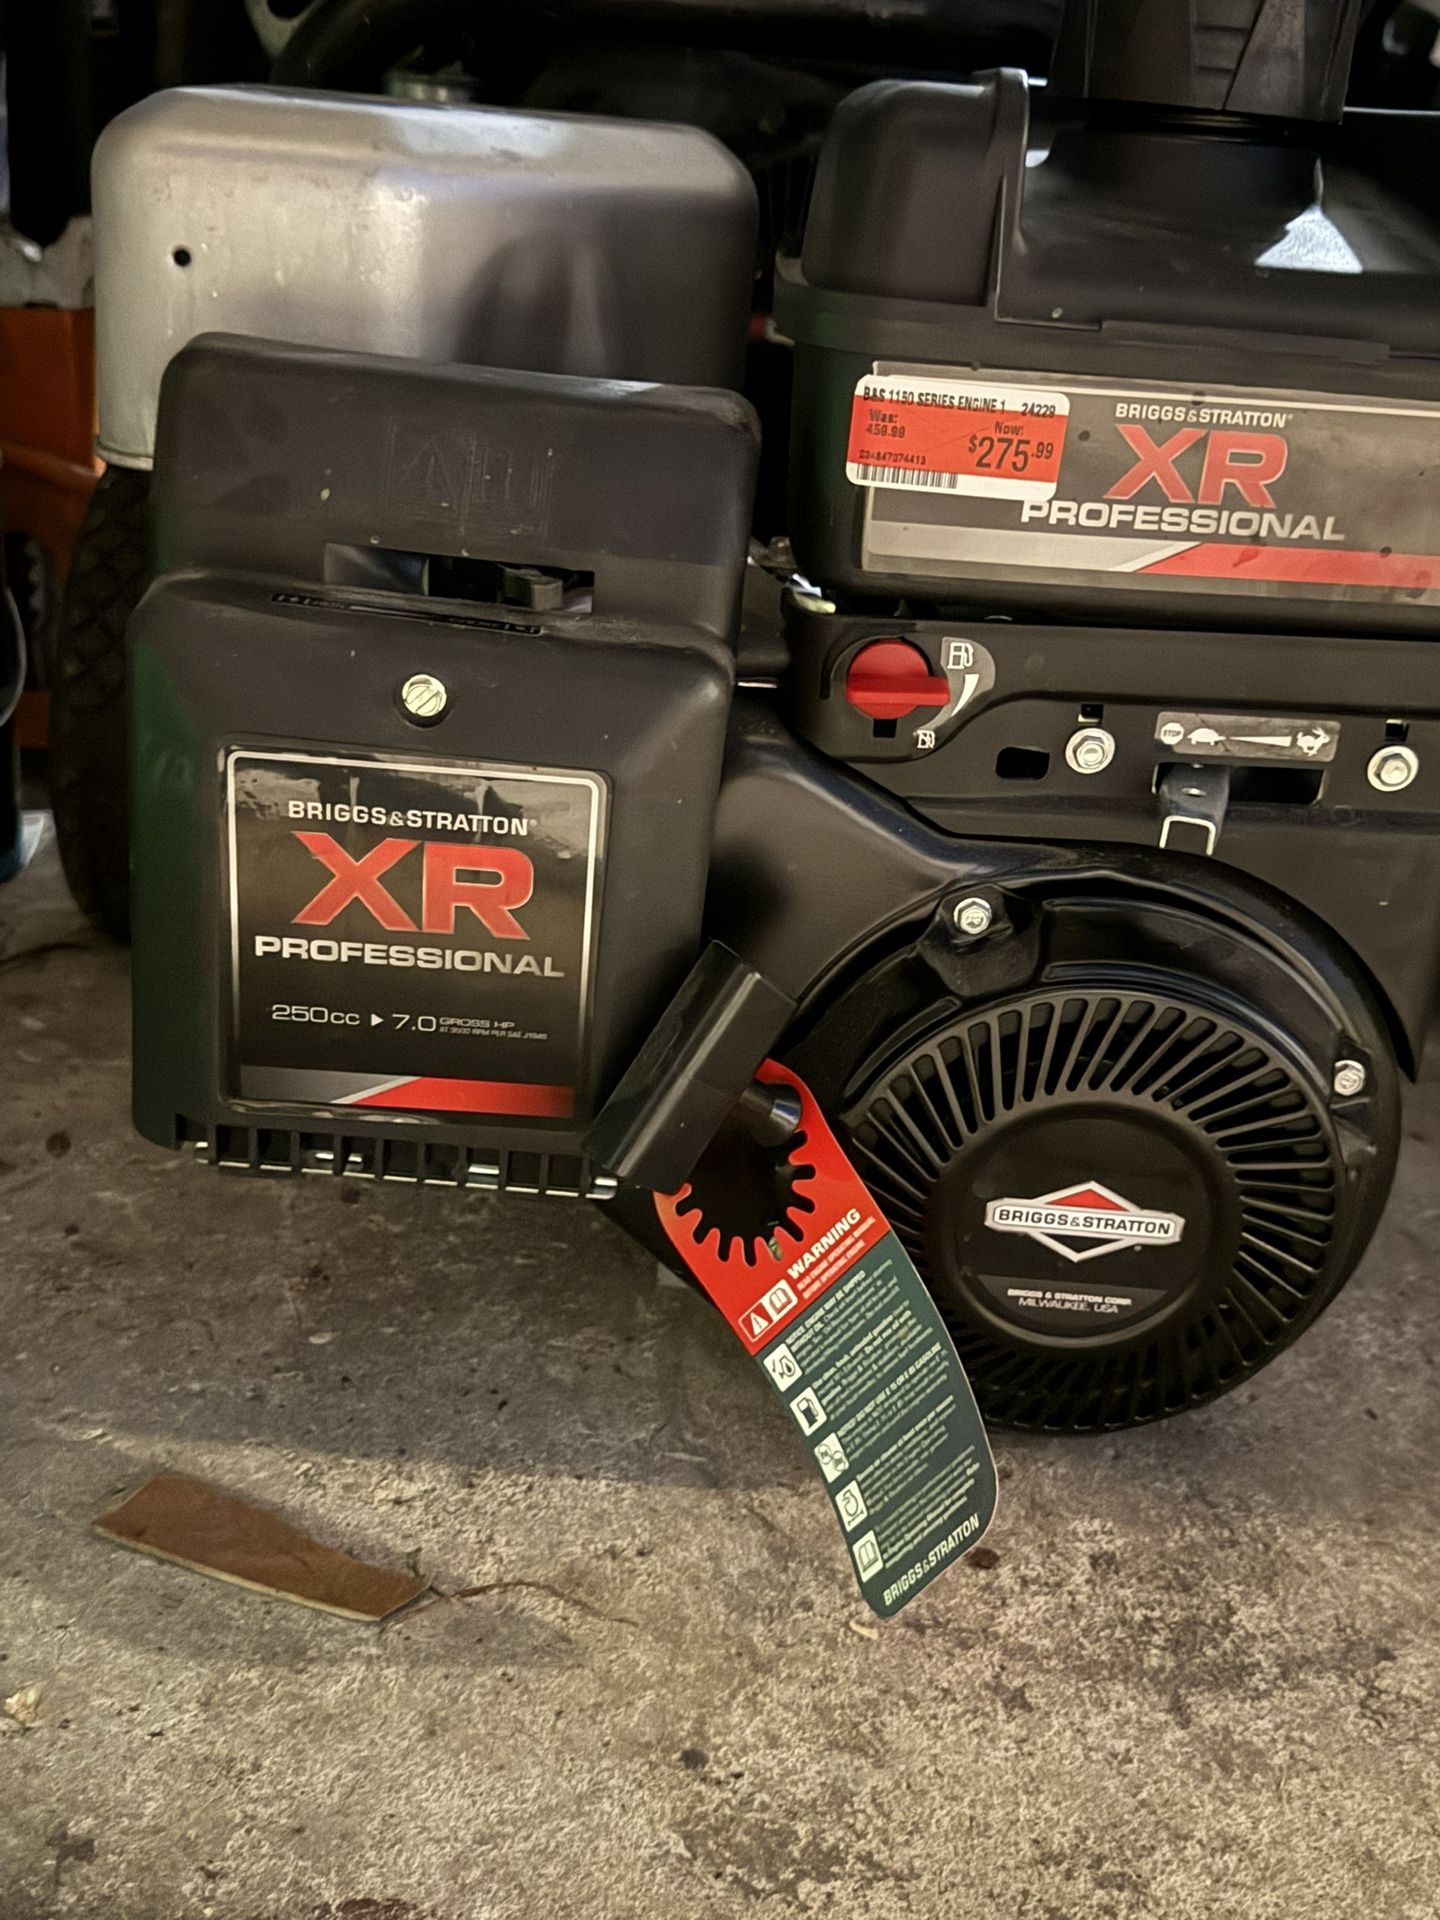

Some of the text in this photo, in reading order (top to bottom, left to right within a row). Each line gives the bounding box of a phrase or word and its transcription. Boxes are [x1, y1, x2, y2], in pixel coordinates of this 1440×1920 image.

[863, 386, 886, 402] B&S
[889, 390, 914, 407] 1150
[917, 392, 955, 411] SERIES
[957, 396, 997, 413] ENGINE
[999, 400, 1006, 414] 1
[994, 421, 1024, 436] Now:
[1103, 423, 1288, 509] XR
[1020, 500, 1346, 542] PROFESSIONAL
[290, 830, 534, 941] XR
[254, 934, 566, 978] PROFESSIONAL
[271, 1003, 516, 1033] 250cc 7.0 GROSS HP
[999, 1209, 1171, 1235] BRIGGS&STRATTON
[786, 1207, 861, 1280] WARNING
[1093, 1301, 1118, 1314] USA
[883, 1513, 979, 1606] BRIGGS&STRATTON
